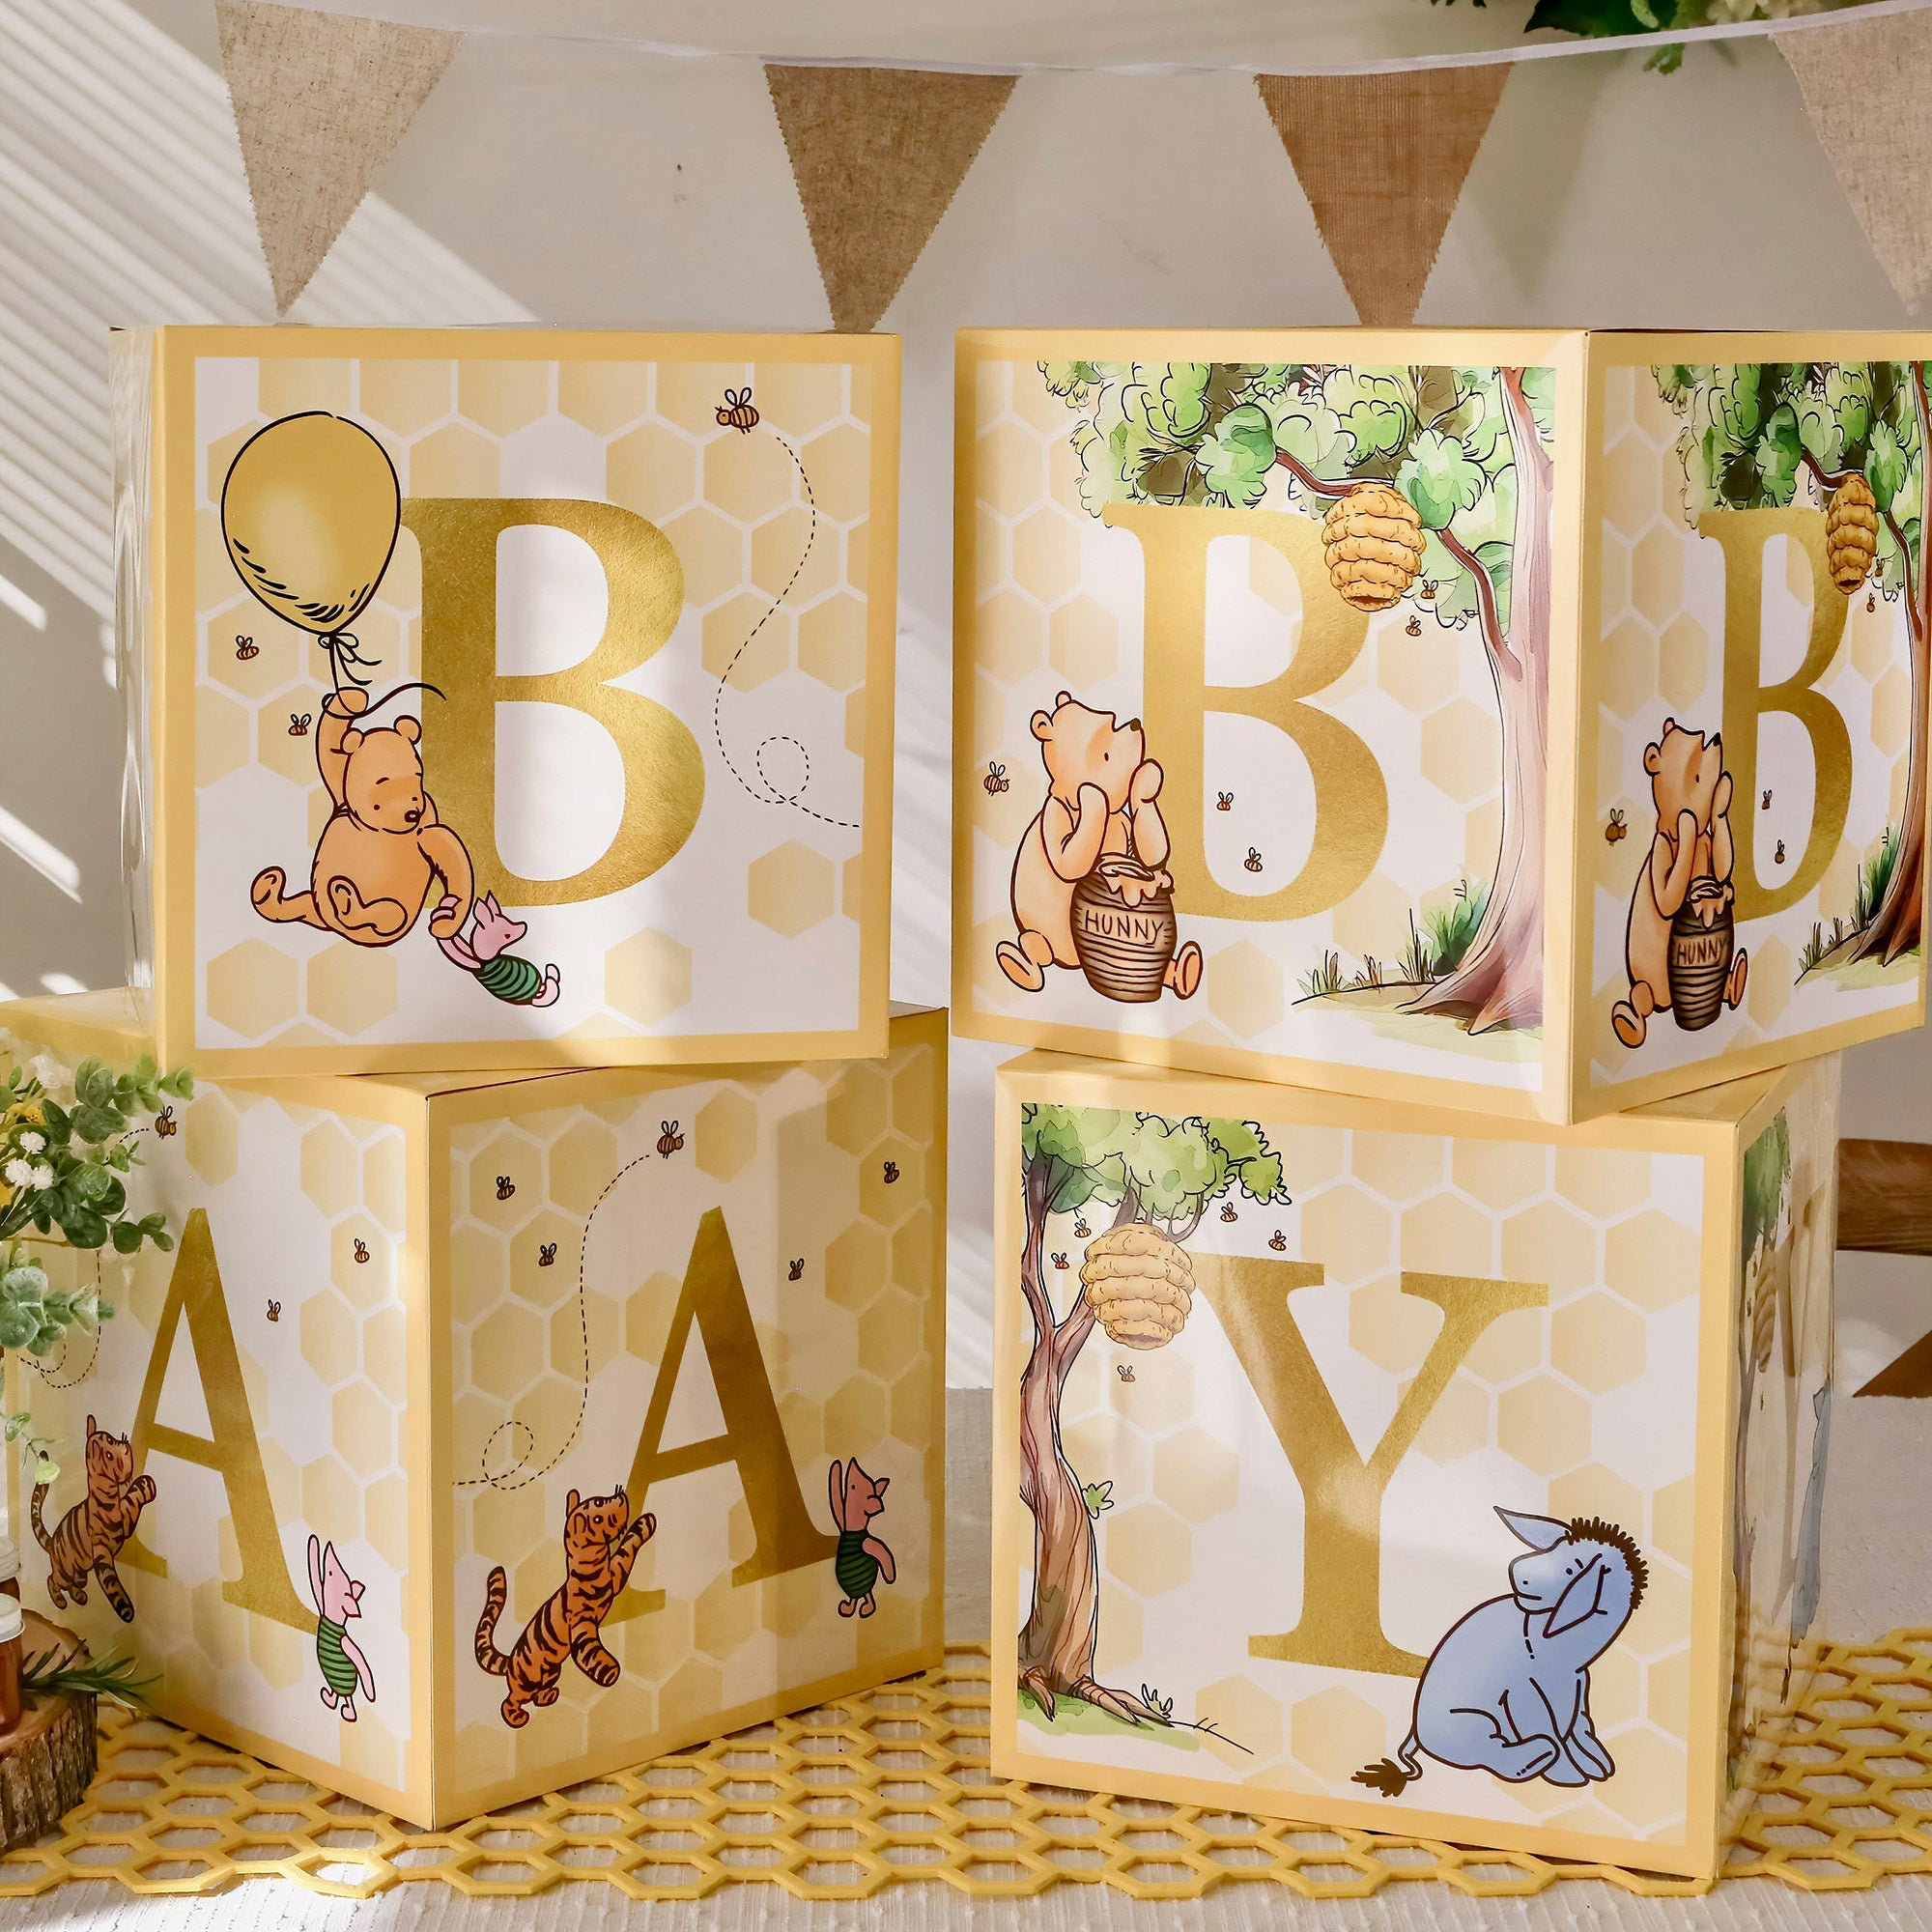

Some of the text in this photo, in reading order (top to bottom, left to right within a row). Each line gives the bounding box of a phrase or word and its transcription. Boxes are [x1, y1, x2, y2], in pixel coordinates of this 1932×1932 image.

[401, 497, 705, 907] B
[1102, 502, 1389, 923] B
[1698, 507, 1853, 922] B
[1085, 909, 1164, 945] HUNNY
[1677, 937, 1726, 965] HUNNY
[115, 1208, 320, 1635] A
[601, 1206, 840, 1629] A
[1192, 1251, 1548, 1678] Y
